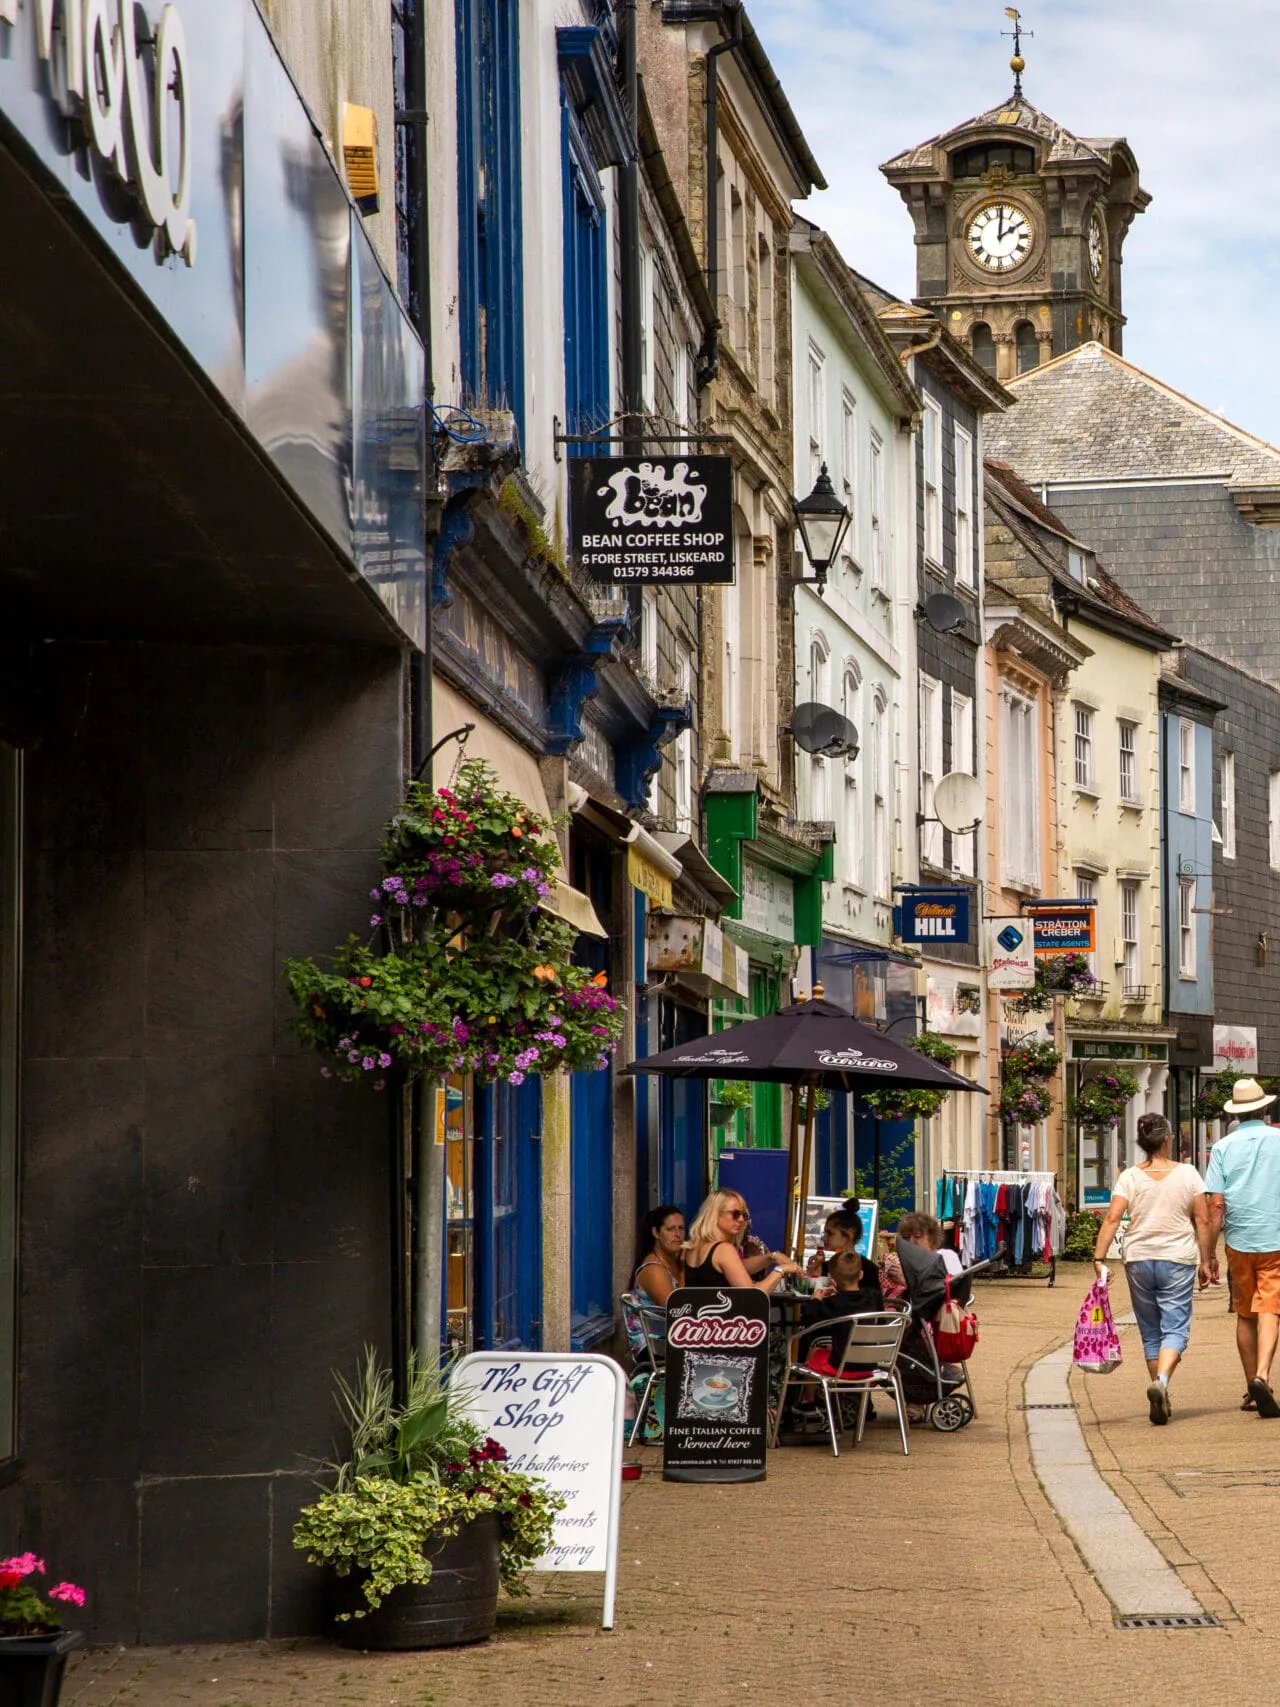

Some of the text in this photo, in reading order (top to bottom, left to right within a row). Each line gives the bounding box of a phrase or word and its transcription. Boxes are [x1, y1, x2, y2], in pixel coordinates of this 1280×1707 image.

[582, 533, 724, 548] BEAN COFFEE SHOP
[582, 552, 725, 565] 6 FORE STREET, LISKEARD
[613, 566, 694, 578] 01579 344366
[914, 917, 956, 936] HILL
[1035, 919, 1087, 929] STRATTON
[1041, 928, 1081, 937] CREBER
[669, 1318, 766, 1345] Carraro
[480, 1363, 594, 1407] The Gift
[494, 1398, 564, 1444] Shop
[678, 1437, 750, 1449] Served here
[525, 1454, 589, 1472] batteries
